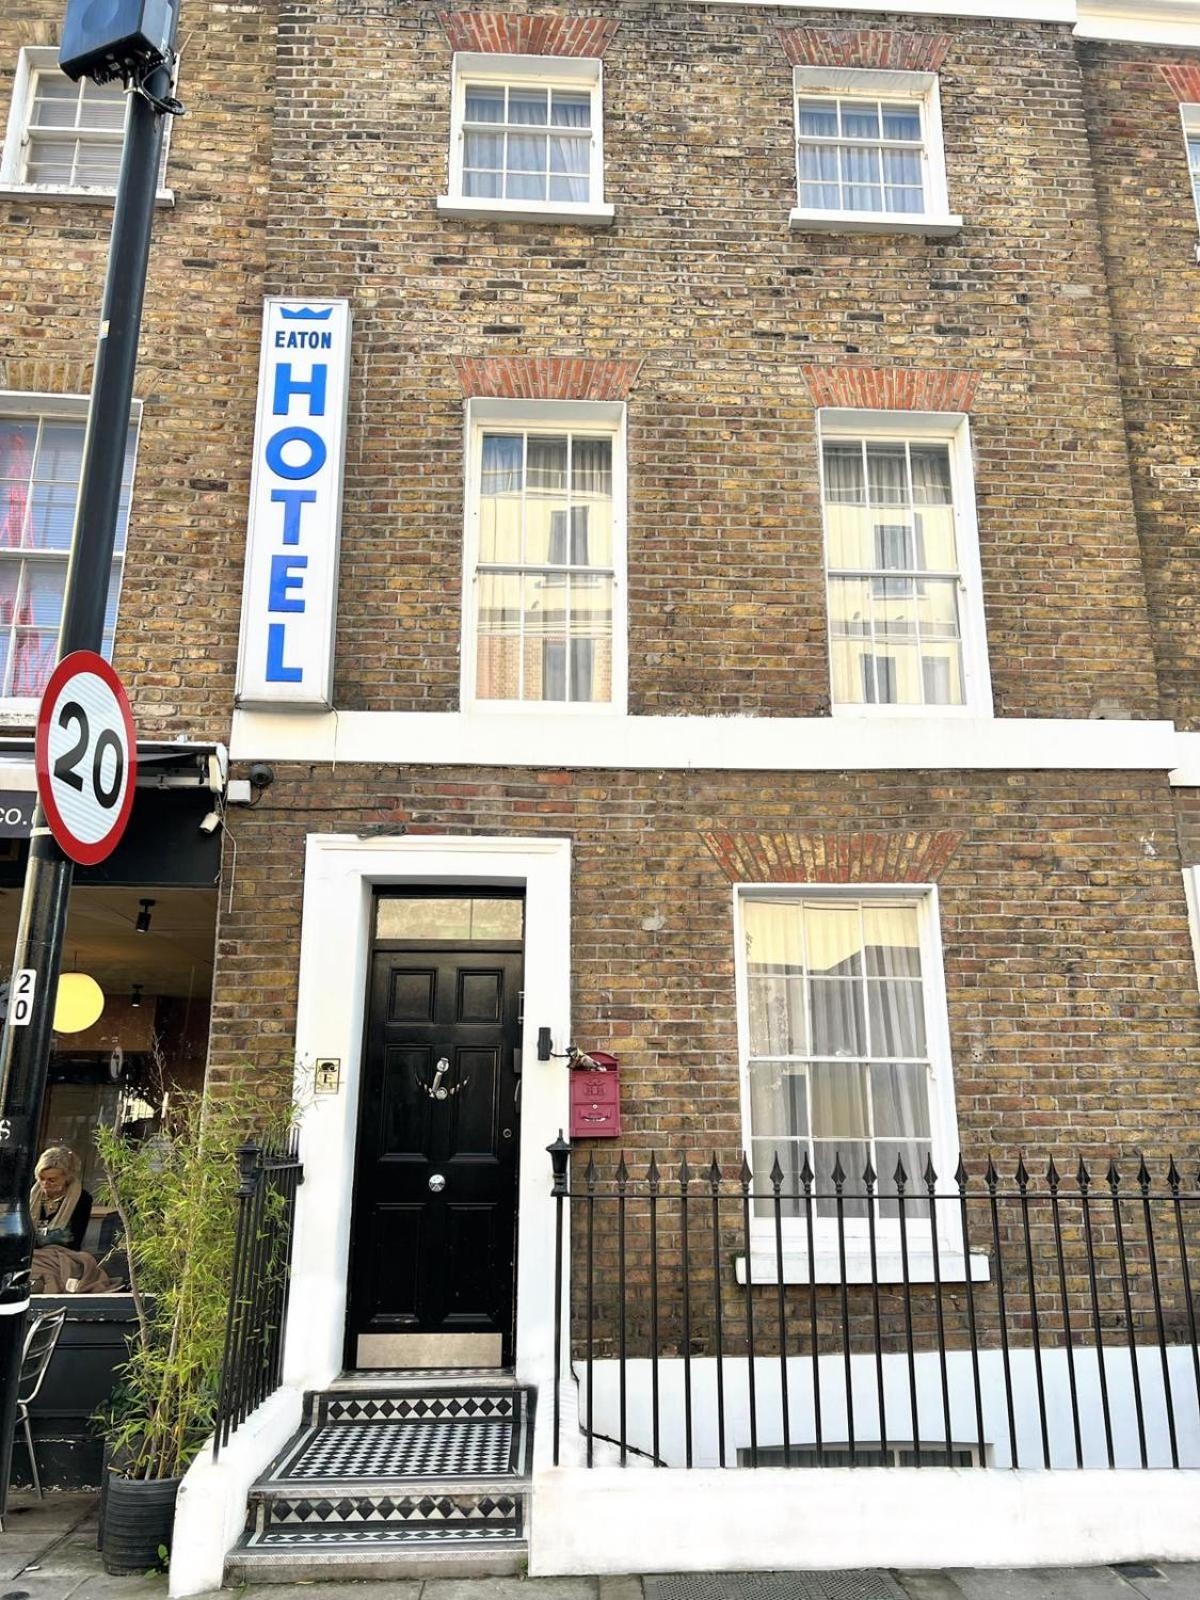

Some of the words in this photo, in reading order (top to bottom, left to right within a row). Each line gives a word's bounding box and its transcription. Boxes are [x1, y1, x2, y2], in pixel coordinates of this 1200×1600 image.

[275, 331, 332, 349] EATON
[265, 362, 328, 683] HOTEL
[53, 701, 124, 809] 20
